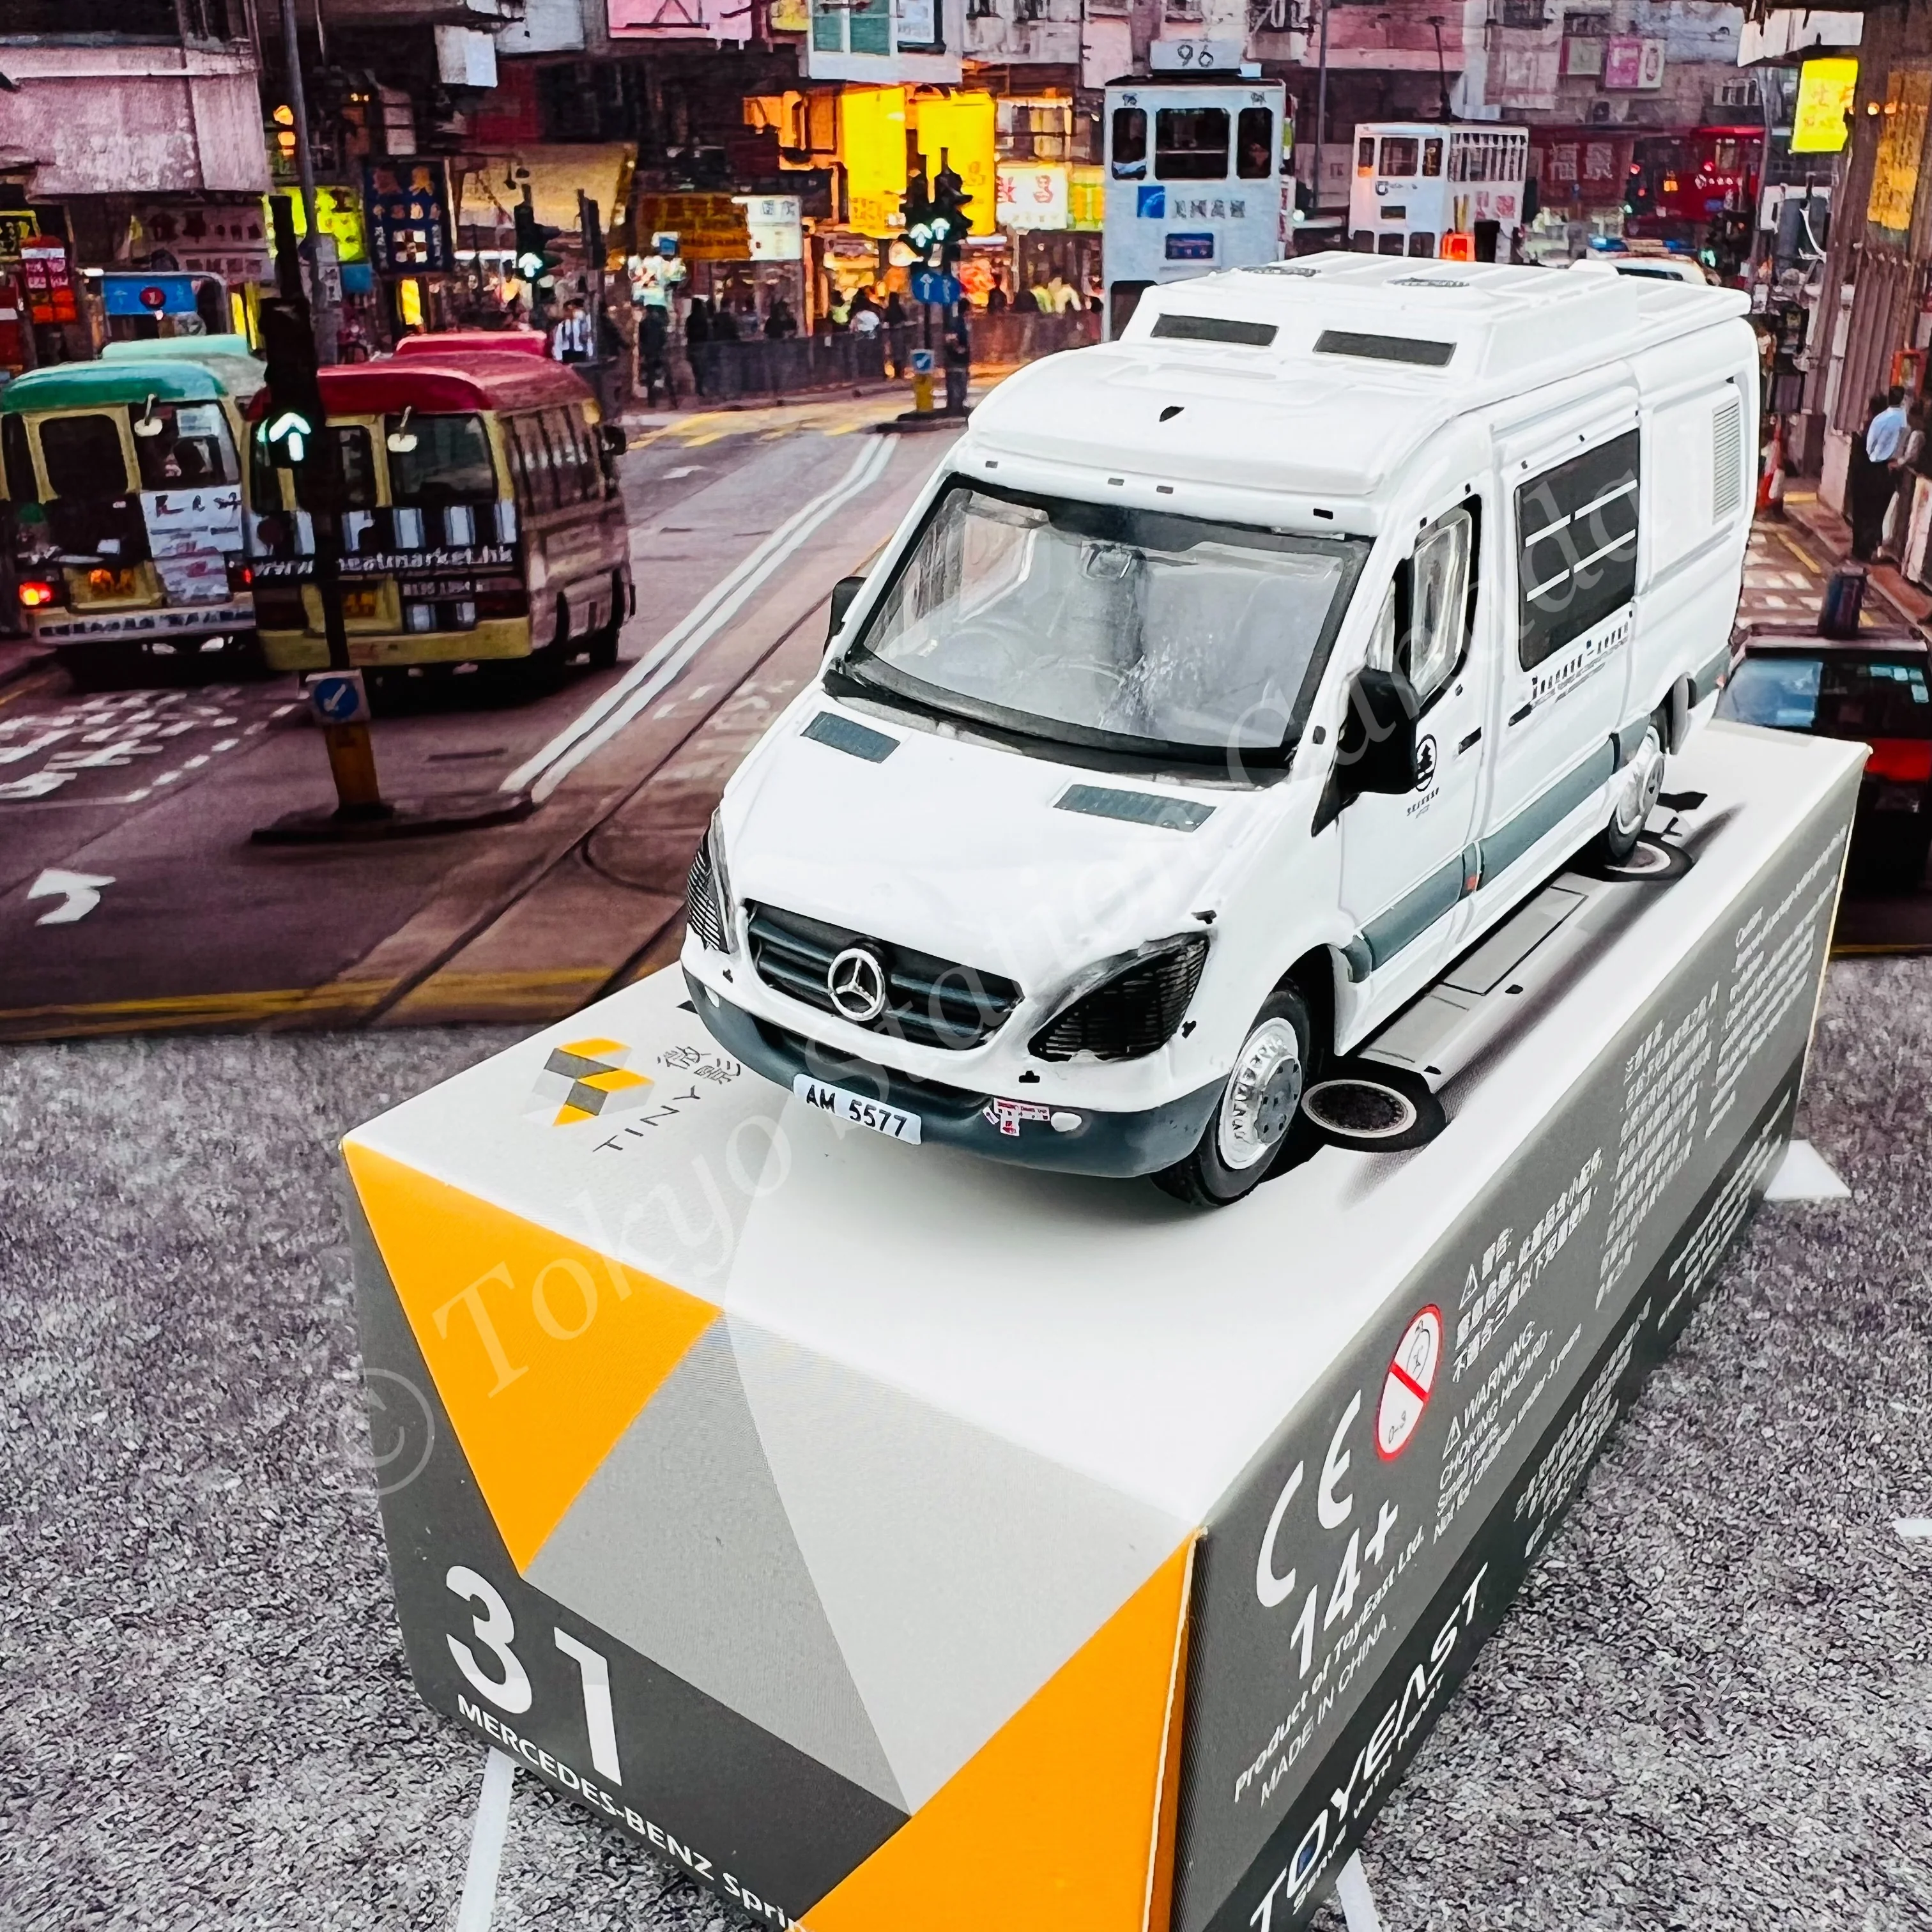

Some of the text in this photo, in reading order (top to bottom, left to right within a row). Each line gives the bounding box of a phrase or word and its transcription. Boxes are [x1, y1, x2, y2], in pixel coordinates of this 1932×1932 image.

[1177, 43, 1214, 67] 96
[592, 1085, 701, 1153] TINY
[806, 1084, 908, 1137] AM 5577
[1440, 1399, 1498, 1490] CHOKING
[1500, 1330, 1547, 1407] HAZARD
[1235, 1526, 1424, 1803] Product of ToyEast Ltd.
[1290, 1499, 1399, 1680] 14+
[457, 1694, 715, 1882] MERCEDES-BENZ
[1250, 1561, 1488, 1932] TOYEAST
[1261, 1614, 1386, 1807] MADE IN CHINA
